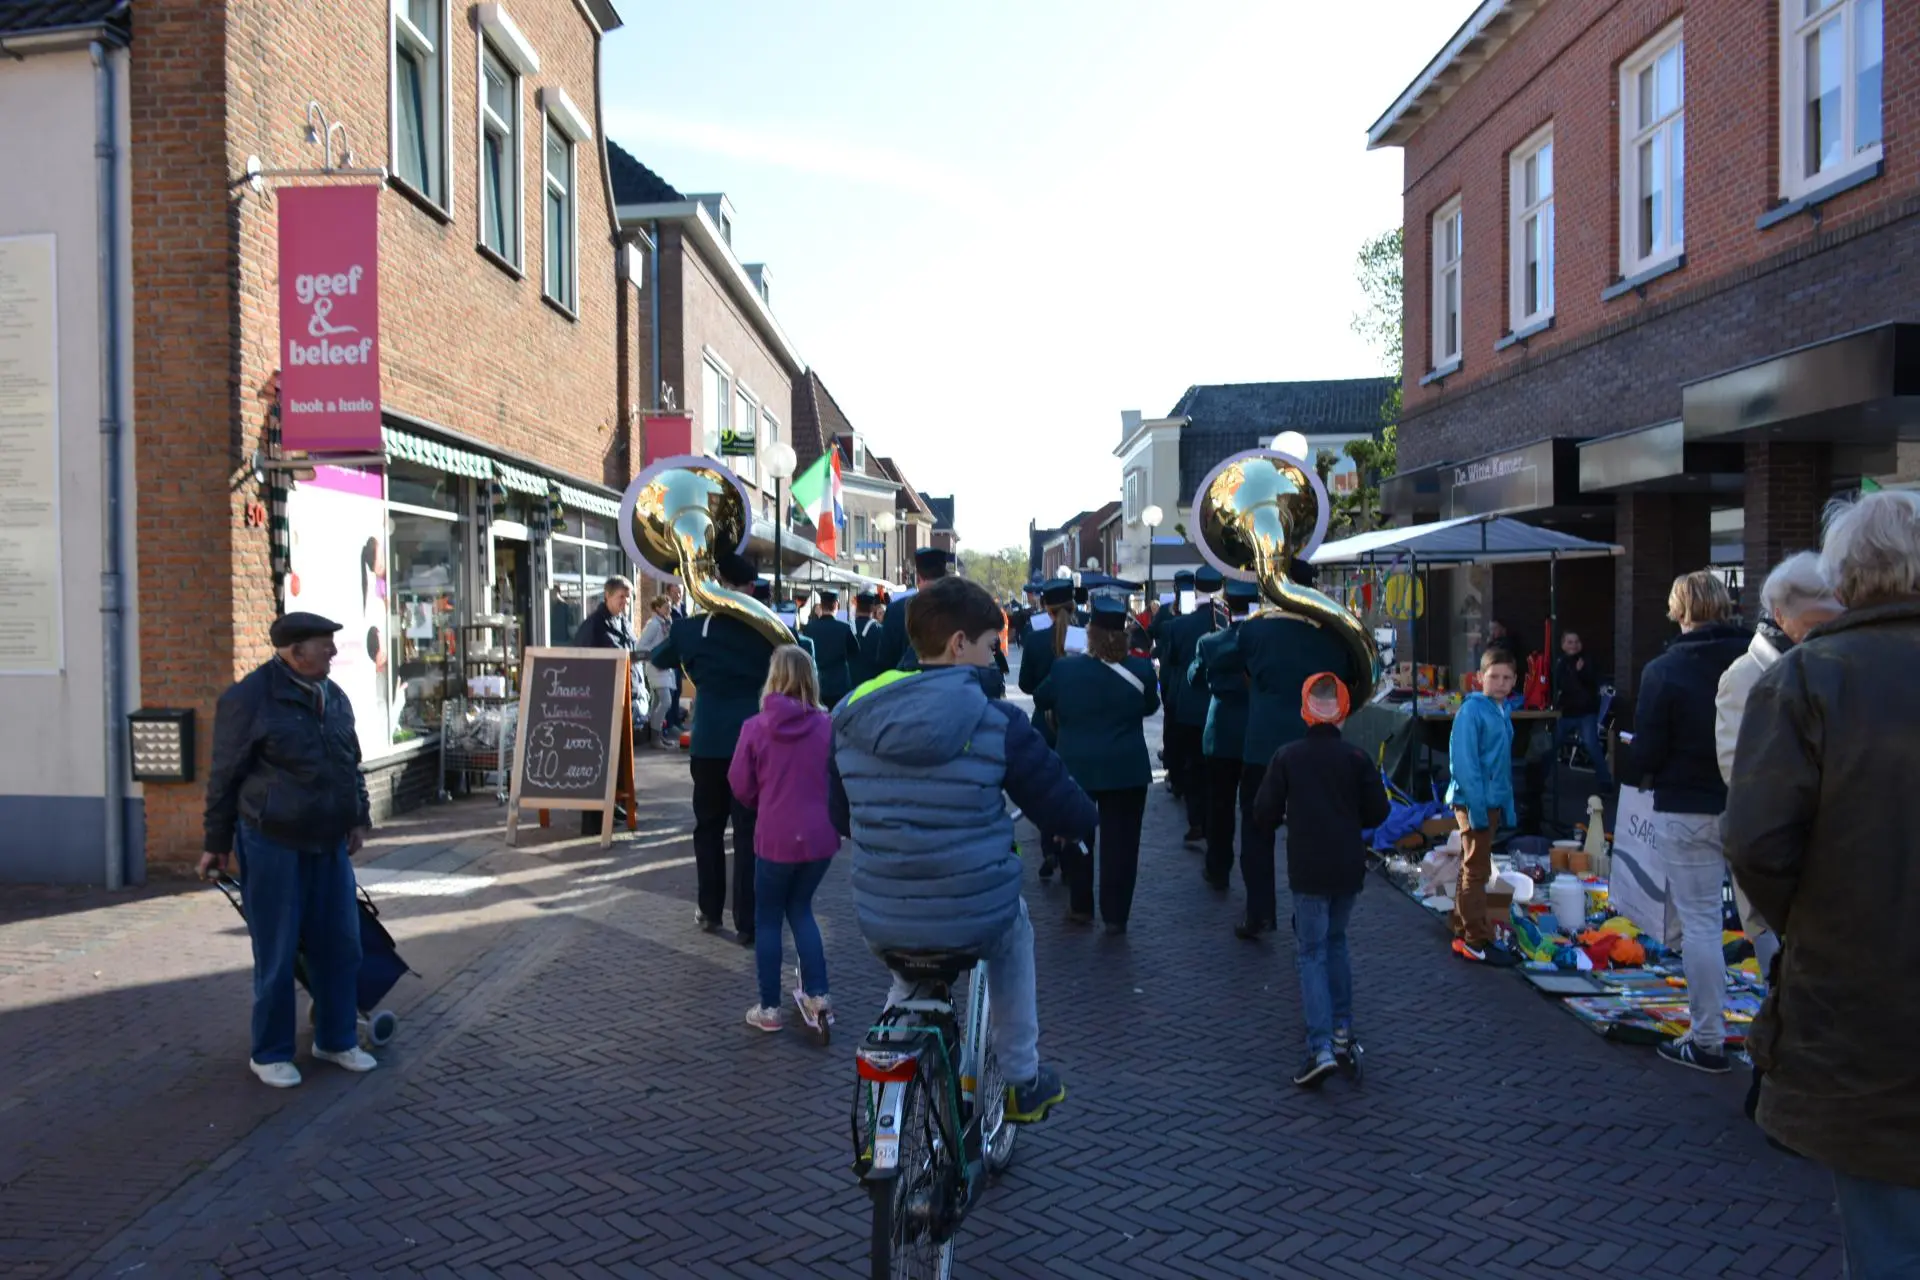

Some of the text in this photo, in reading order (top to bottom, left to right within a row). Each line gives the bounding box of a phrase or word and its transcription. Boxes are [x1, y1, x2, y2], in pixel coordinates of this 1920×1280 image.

[295, 264, 363, 304] geef
[308, 297, 359, 337] &
[288, 337, 373, 366] beleef
[1468, 463, 1491, 481] Witte
[1492, 456, 1523, 476] Kamer
[247, 503, 265, 527] 50
[539, 725, 594, 750] 3 voor
[533, 750, 594, 779] 10 euro
